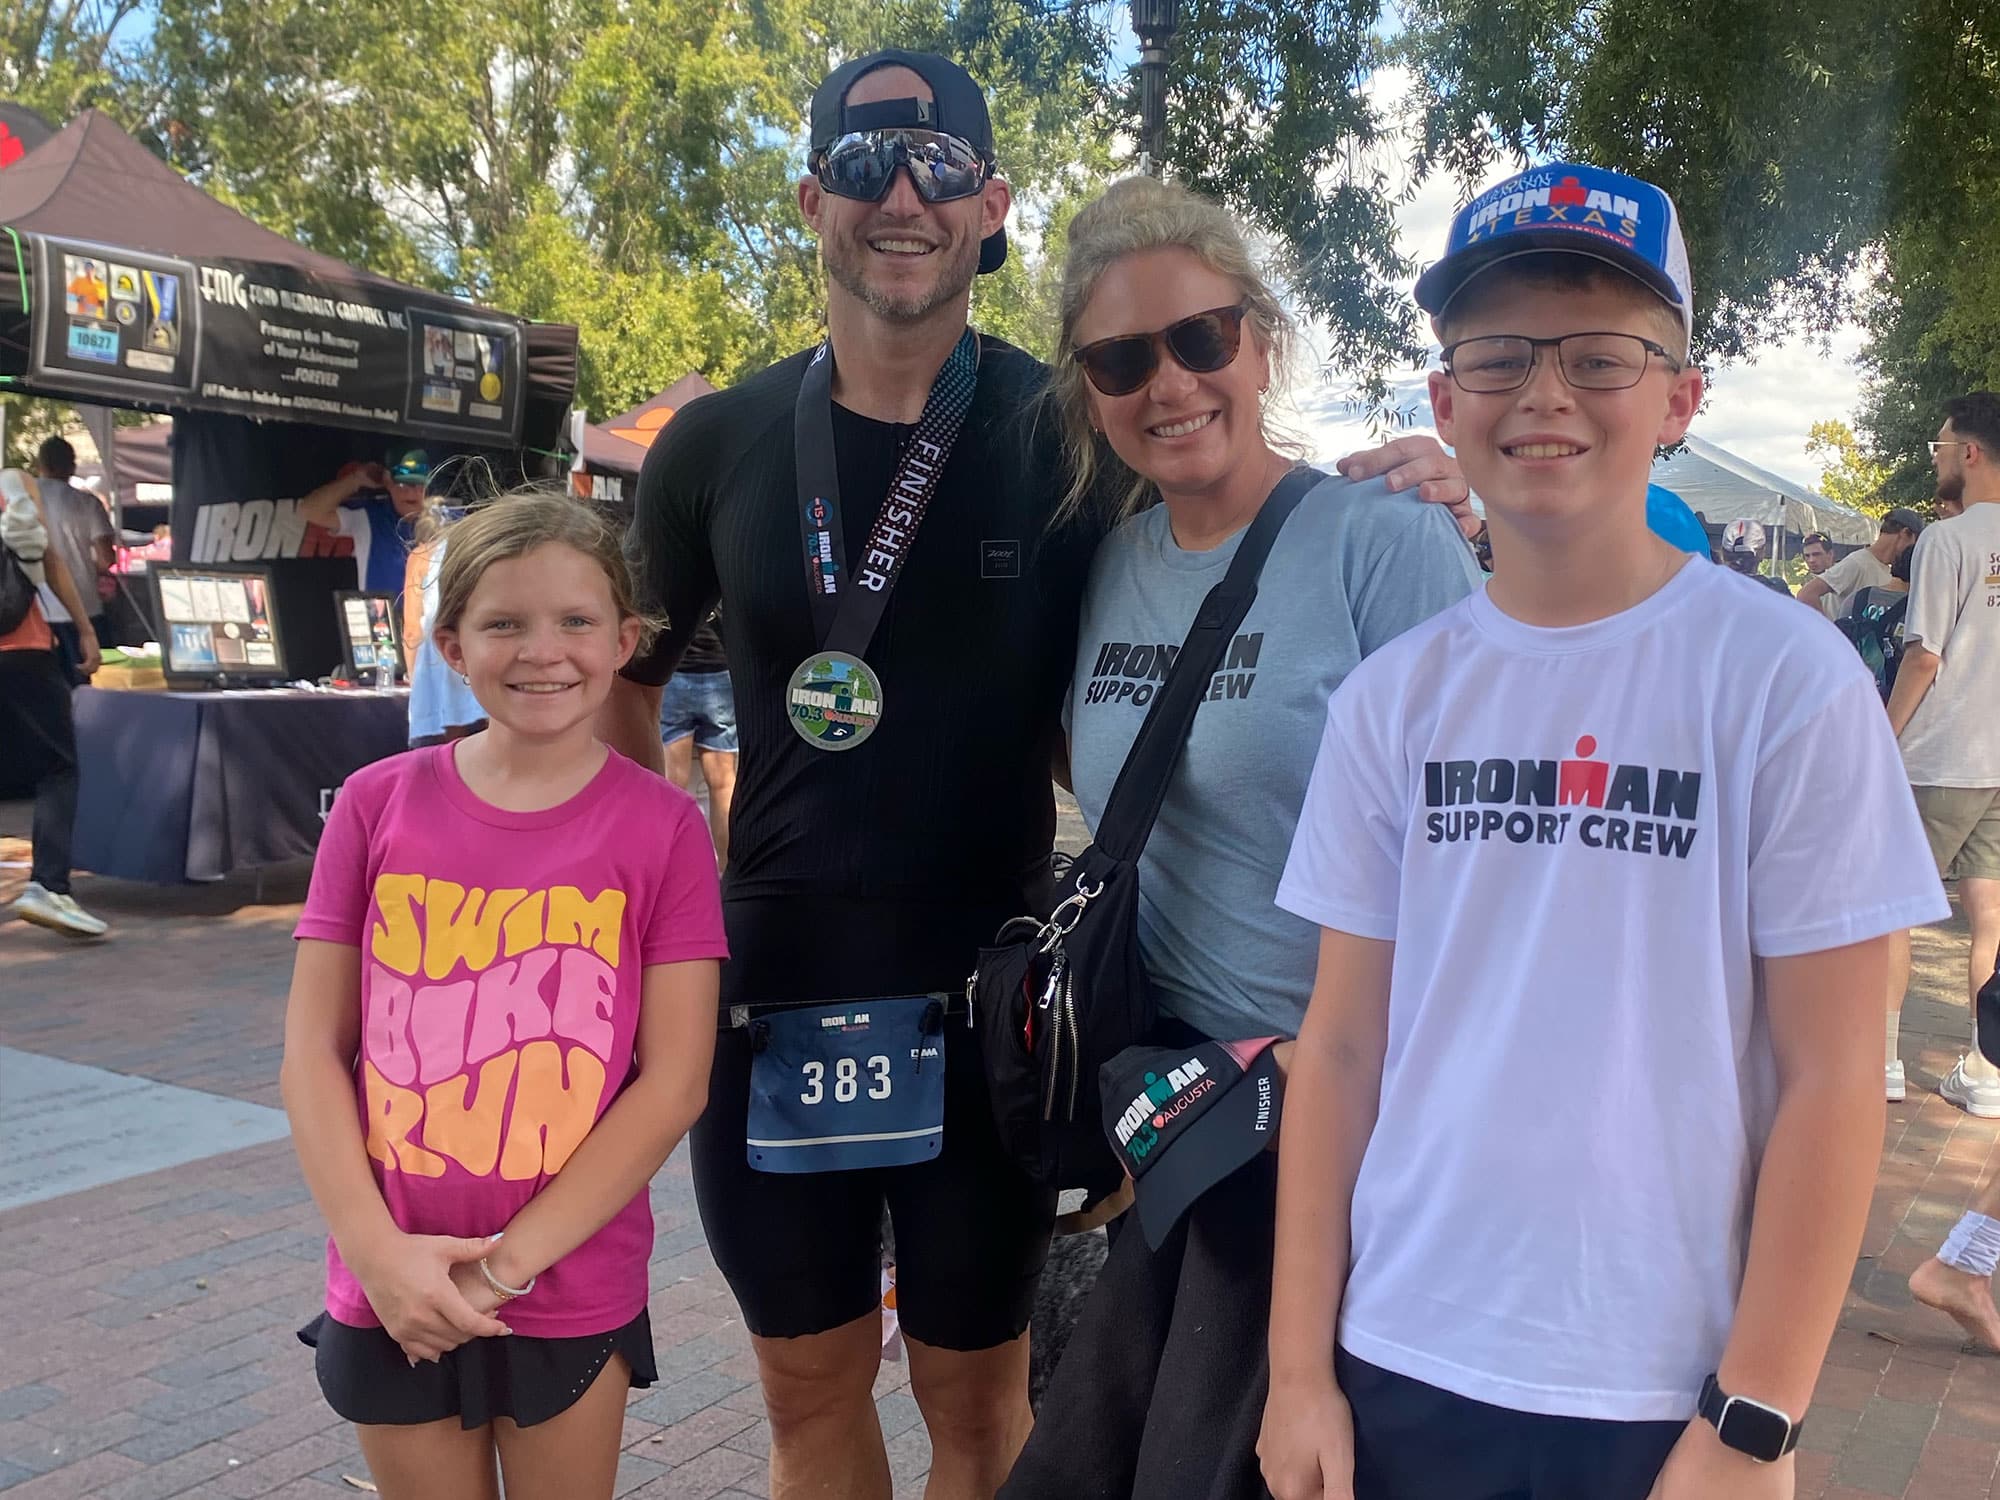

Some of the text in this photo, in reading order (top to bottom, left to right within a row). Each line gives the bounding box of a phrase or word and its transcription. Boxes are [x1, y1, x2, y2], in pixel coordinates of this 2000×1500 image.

[1468, 176, 1640, 236] IRONMAN
[1488, 206, 1637, 238] TEXAS
[200, 266, 248, 311] FMG
[858, 440, 941, 592] FINISHER
[818, 531, 840, 594] IRONMAN
[1092, 633, 1264, 681] IRONN
[791, 687, 880, 716] IRONMAN
[791, 704, 824, 721] 70.3
[1425, 735, 1702, 821] IRONMAN
[1426, 810, 1698, 859] SUPPORT CREW
[371, 873, 627, 981] SWIM
[366, 947, 617, 1086] BIKE
[821, 1012, 870, 1028] IRONMAN
[801, 1055, 892, 1105] 383
[1114, 1056, 1209, 1147] IRONMAN
[1254, 1076, 1272, 1131] FINISHER
[364, 1040, 606, 1181] RUN
[1126, 1077, 1217, 1165] 70.3 AUGUSTA
